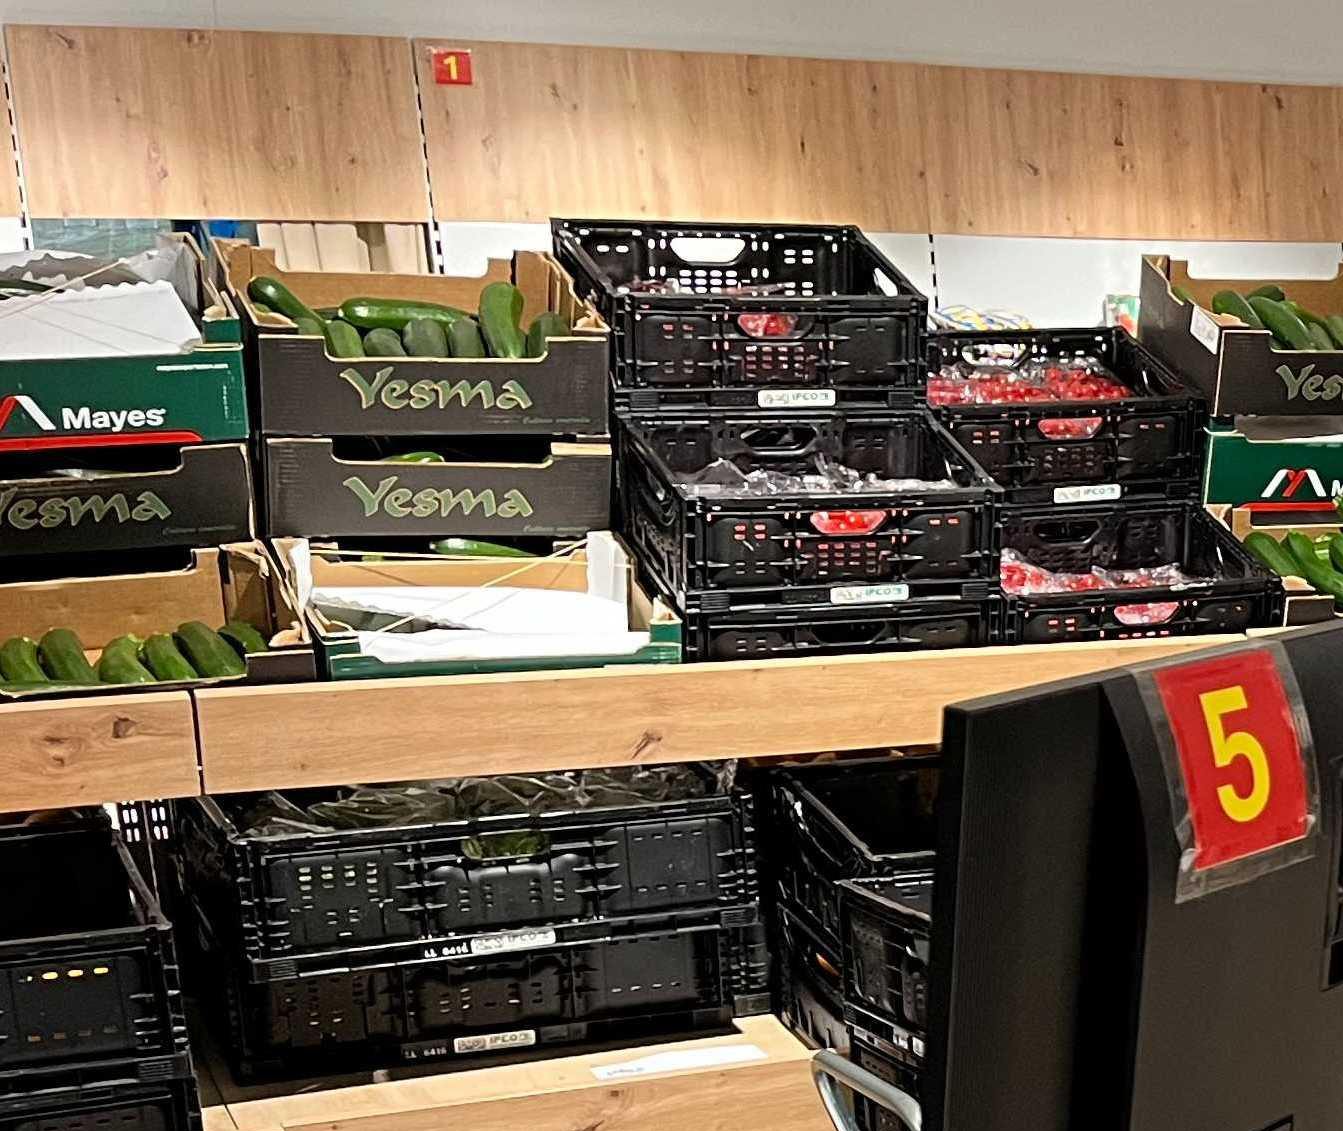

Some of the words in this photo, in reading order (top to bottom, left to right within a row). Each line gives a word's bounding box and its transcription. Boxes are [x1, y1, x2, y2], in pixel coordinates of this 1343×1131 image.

[442, 55, 459, 80] 1
[340, 366, 533, 409] Yesma
[62, 407, 166, 432] Mayes
[342, 476, 533, 518] Yesma
[1199, 685, 1271, 823] 5
